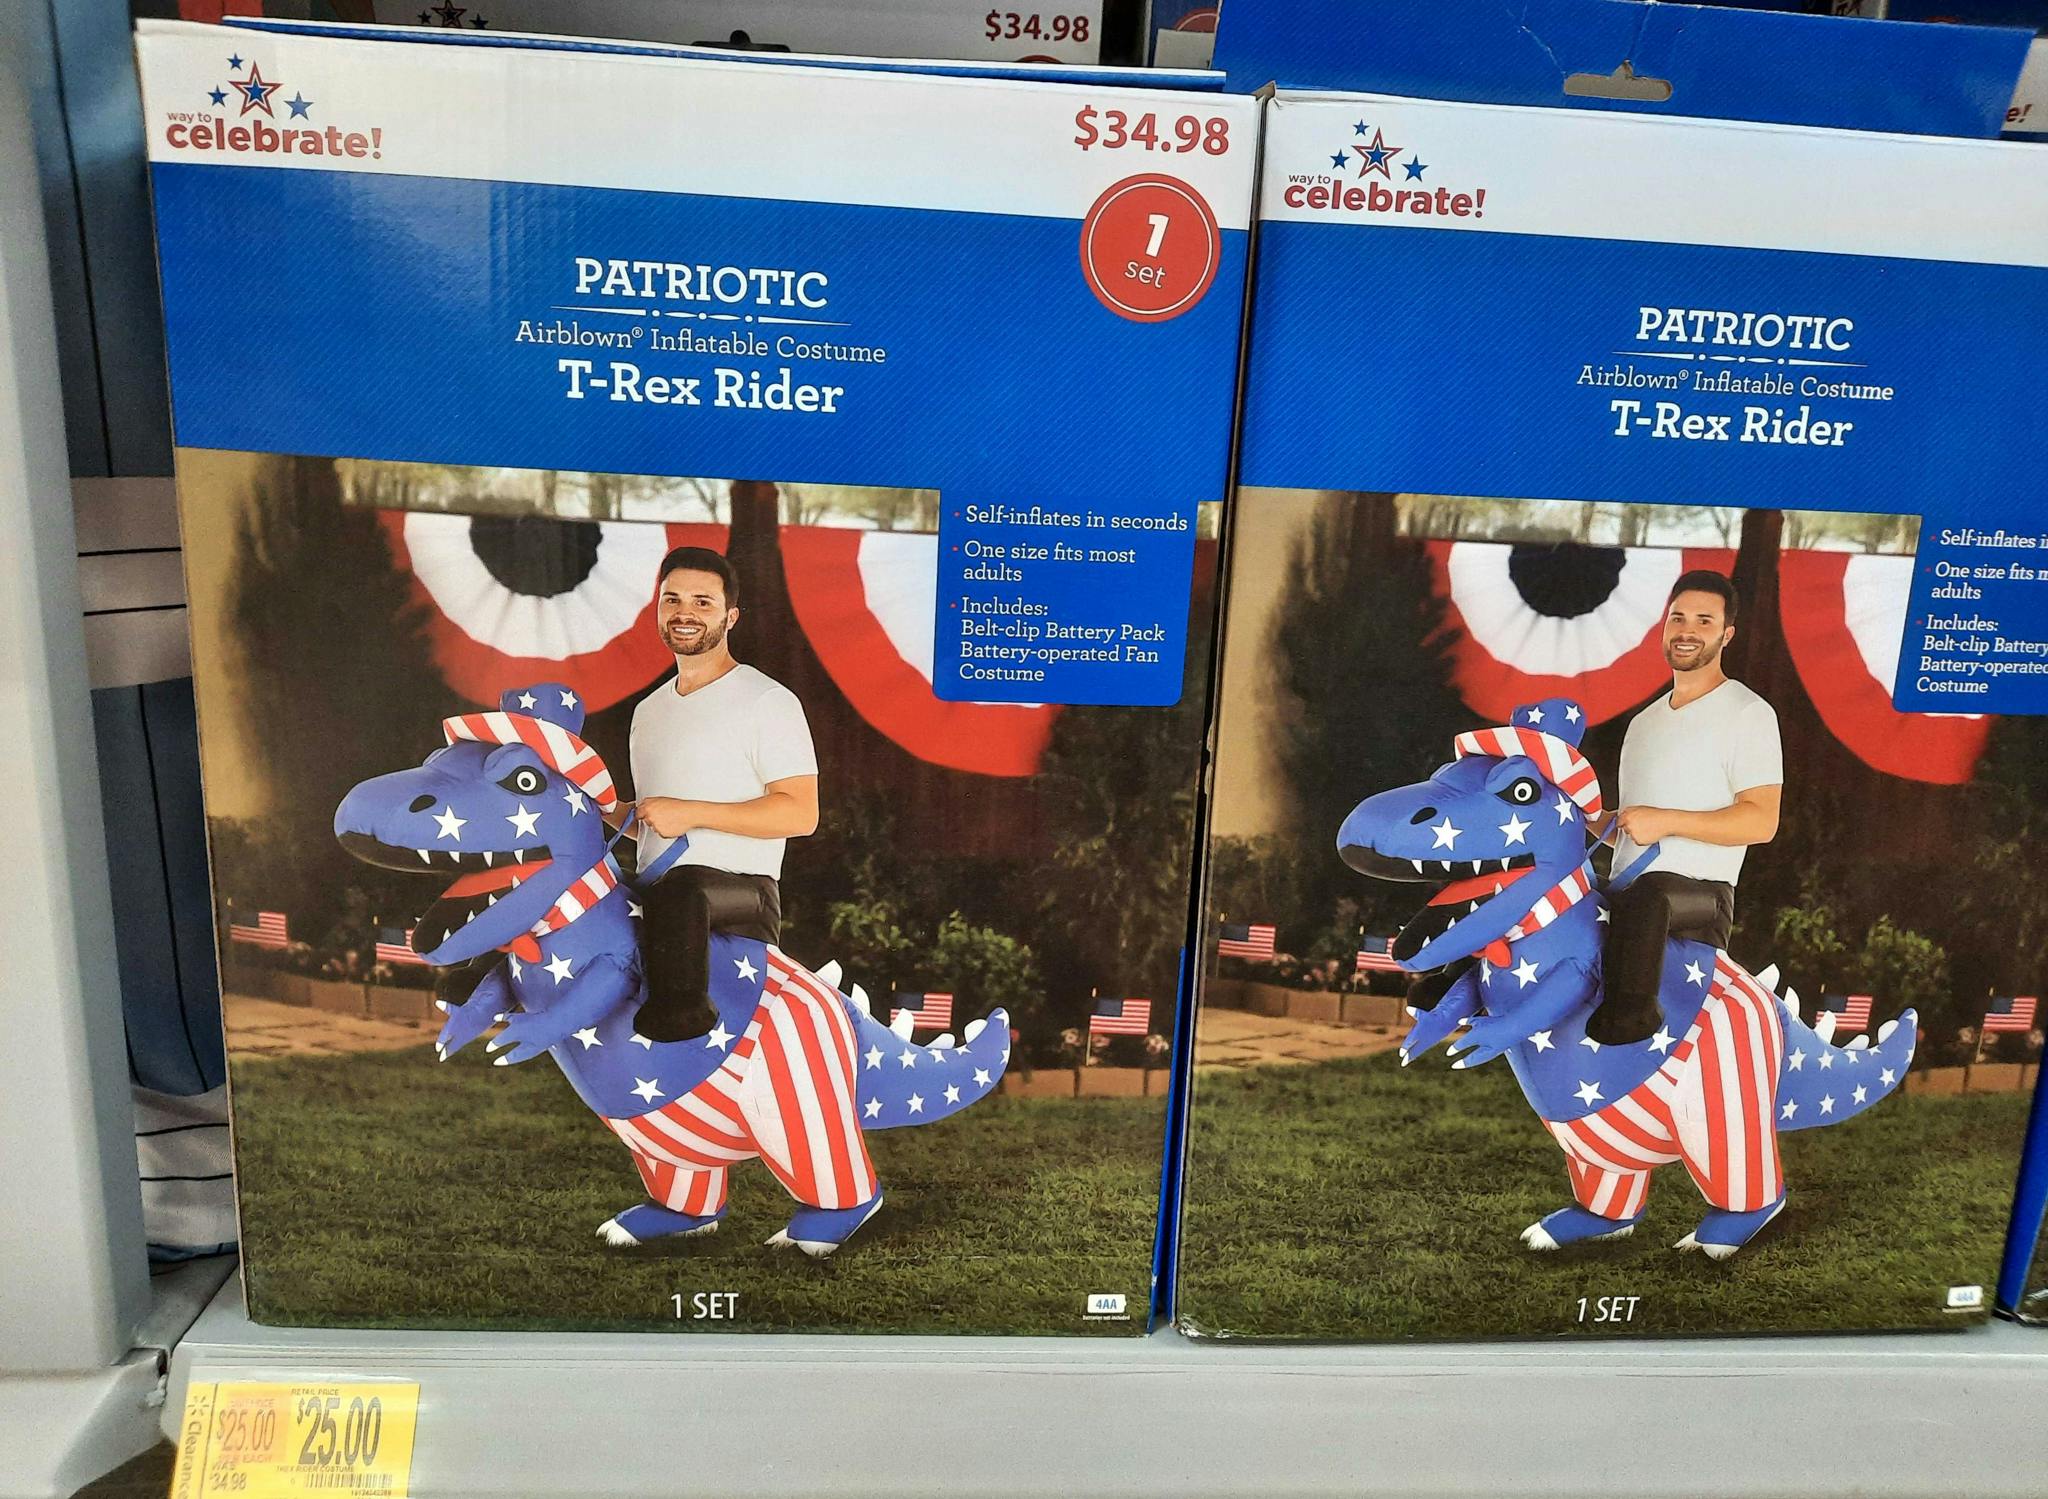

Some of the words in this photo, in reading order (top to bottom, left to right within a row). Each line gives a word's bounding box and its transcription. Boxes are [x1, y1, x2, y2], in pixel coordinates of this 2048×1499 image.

[985, 9, 1090, 42] $34.98
[167, 112, 195, 124] way
[198, 112, 212, 123] to
[1073, 104, 1230, 156] $34.98
[166, 118, 382, 159] celebrate!
[1288, 174, 1314, 185] way
[1317, 174, 1331, 185] to
[1284, 180, 1486, 218] celebrate!
[1145, 213, 1169, 257] 1
[575, 257, 828, 308] PATRIOTIC
[1124, 259, 1166, 289] set
[1636, 306, 1853, 351] PATRIOTIC
[650, 328, 769, 357] Inflatable
[776, 336, 886, 363] Costume
[558, 359, 701, 405] T-Rex
[714, 367, 844, 413] Rider
[1693, 370, 1794, 396] Inflatable
[1800, 377, 1894, 401] Costume
[1611, 399, 1731, 441] T-Rex
[1740, 406, 1853, 446] Rider
[965, 505, 1081, 527] Self-inflates
[1086, 511, 1105, 528] in
[1111, 513, 1188, 531] seconds
[964, 540, 1005, 559] One
[1010, 543, 1048, 560] size
[1053, 542, 1083, 561] fits
[1088, 547, 1136, 563] most
[1940, 529, 2037, 549] Self-inflates
[963, 562, 1023, 581] adults
[1935, 561, 1970, 578] One
[1974, 564, 2005, 580] size
[2008, 562, 2035, 580] fits
[1931, 582, 1982, 600] adults
[961, 596, 1049, 616] Includes:
[961, 620, 1040, 641] Belt-clip
[1045, 622, 1115, 643] Battery
[1120, 623, 1165, 641] Pack
[1926, 614, 1999, 631] Includes:
[960, 642, 1120, 664] Battery-operated
[1125, 646, 1159, 662] Fan
[1923, 635, 1989, 656] Belt-clip
[1993, 637, 2048, 658] Battery
[959, 664, 1045, 682] Costume
[1916, 677, 1989, 693] Costume
[670, 1293, 682, 1319] 1
[693, 1292, 740, 1319] SET
[1095, 1298, 1117, 1310] 4AA
[1577, 1297, 1587, 1322] 1
[1594, 1296, 1641, 1322] SET
[318, 1388, 339, 1396] PRICE
[217, 1409, 276, 1451] $25.00
[297, 1396, 381, 1466] $25.00
[177, 1421, 202, 1499] Clearance
